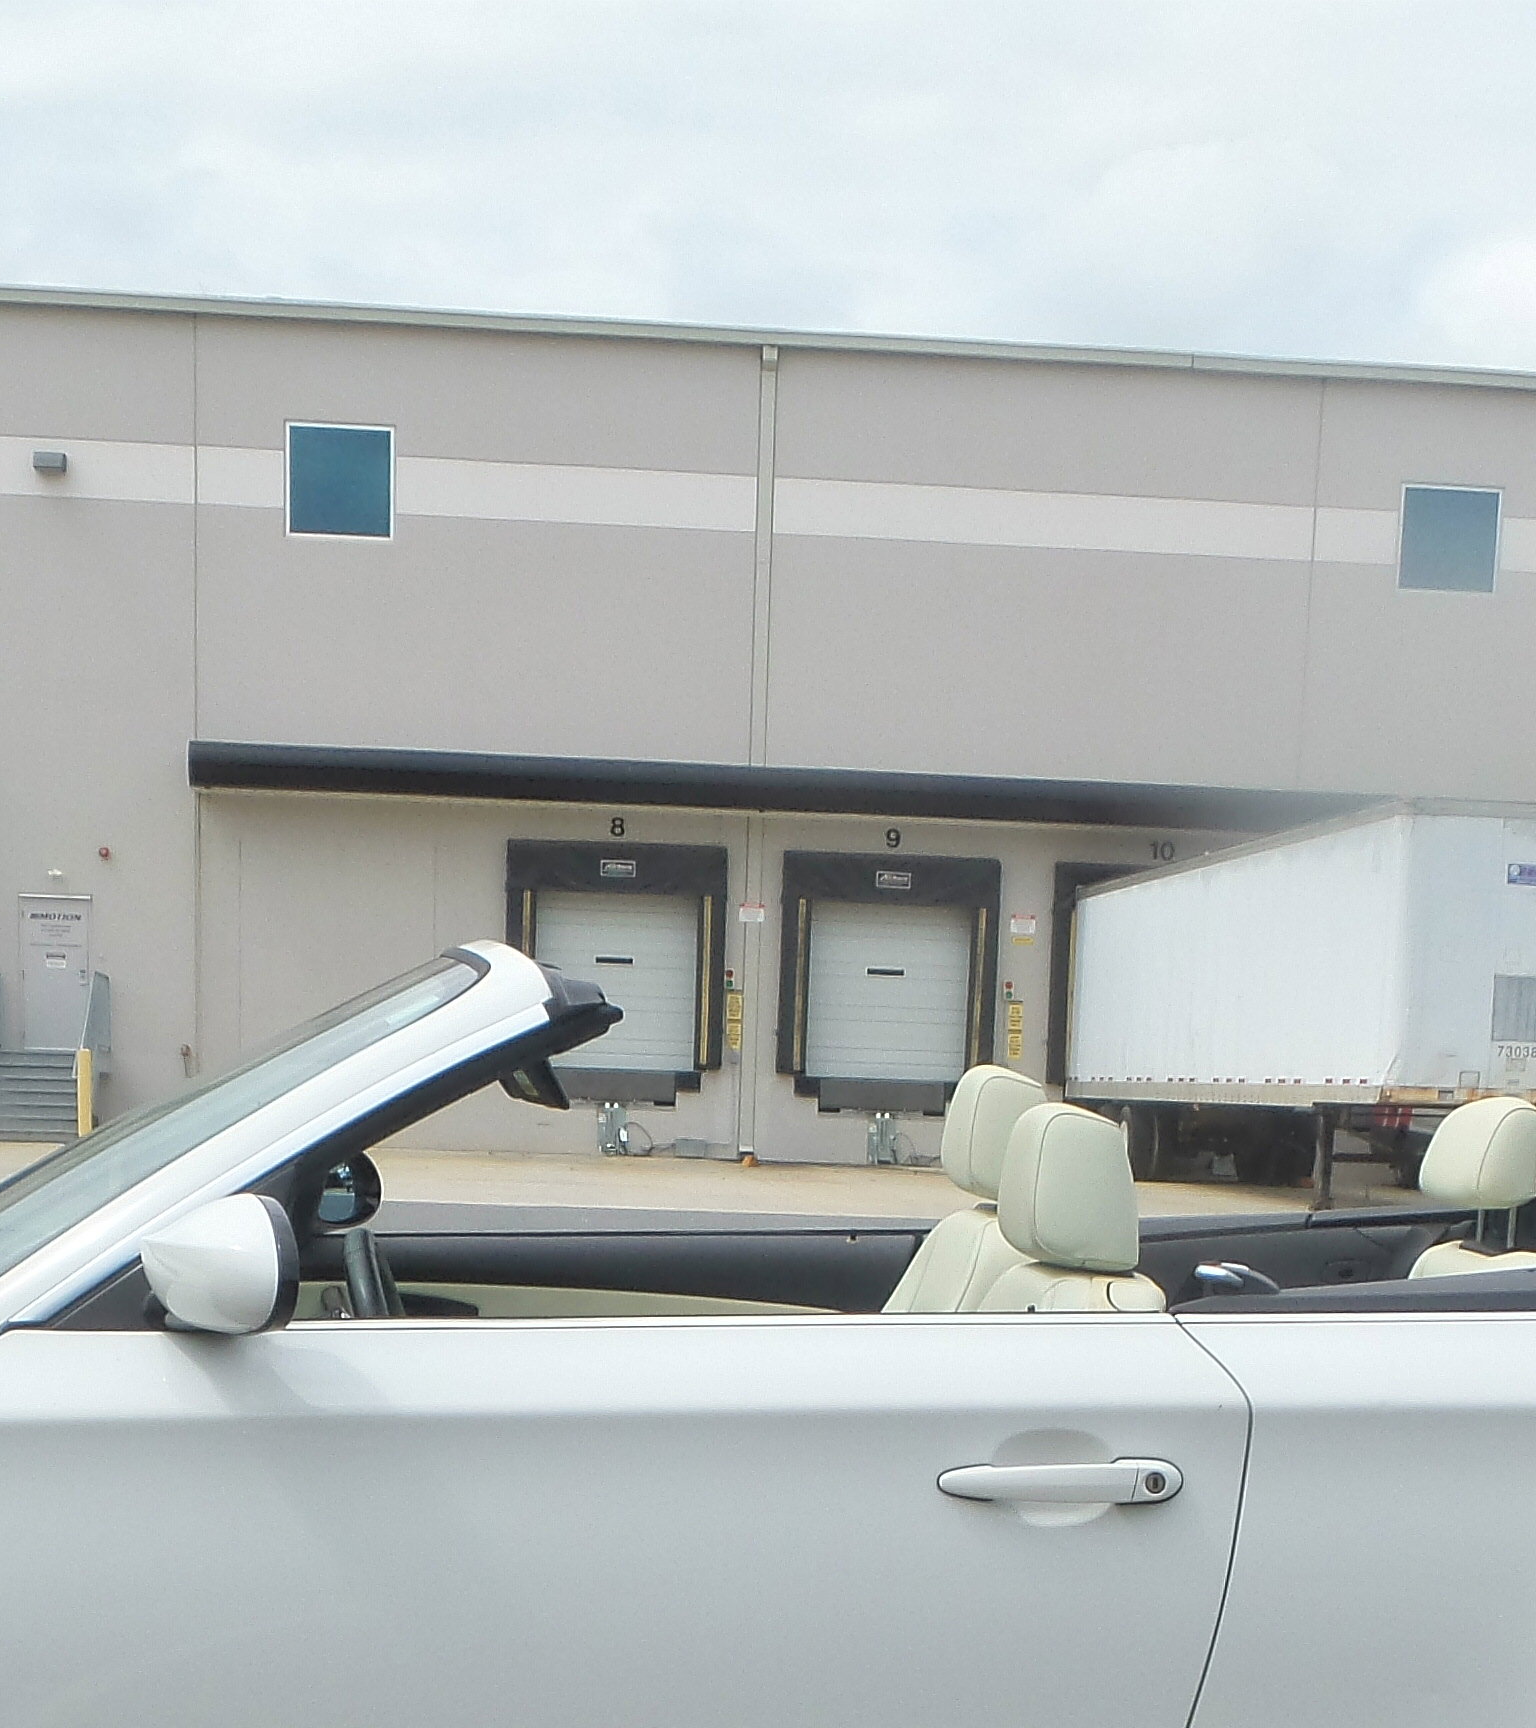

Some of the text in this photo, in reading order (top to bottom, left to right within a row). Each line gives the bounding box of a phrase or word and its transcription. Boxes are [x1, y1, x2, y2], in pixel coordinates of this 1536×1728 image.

[610, 816, 625, 837] 8
[886, 828, 901, 848] 9
[1148, 840, 1176, 861] 10
